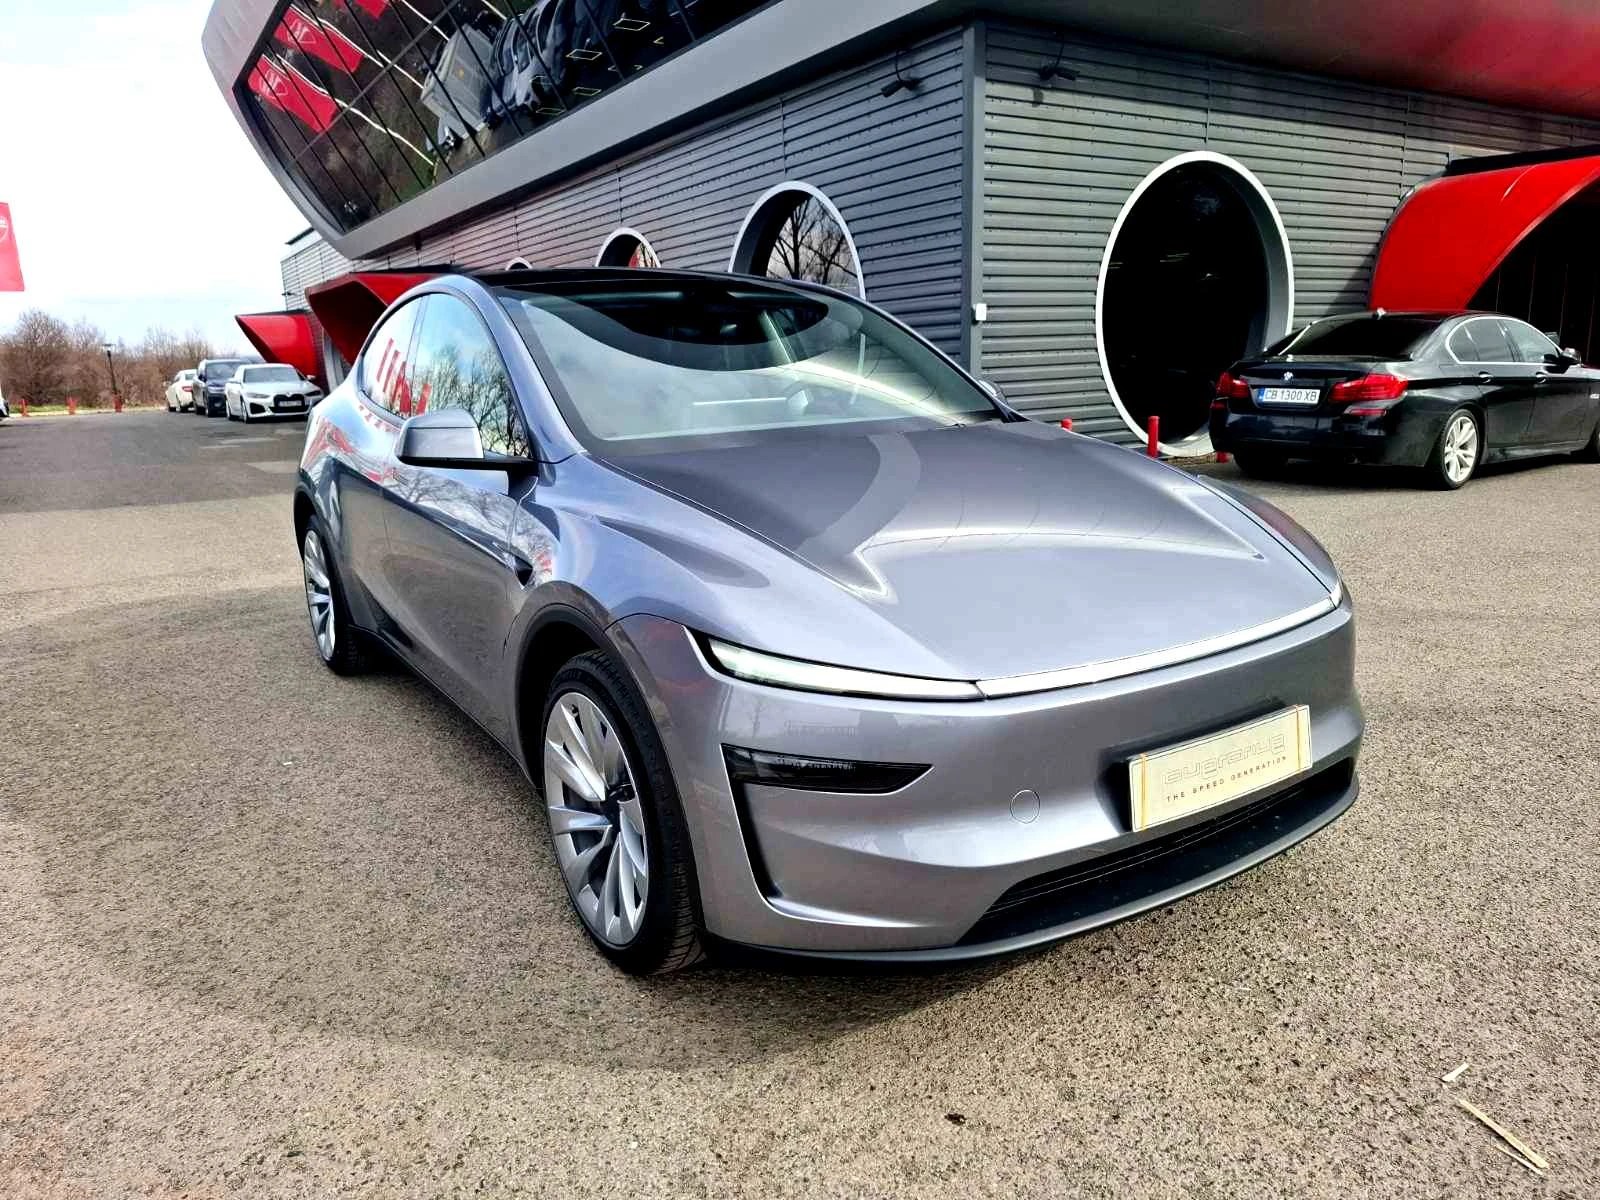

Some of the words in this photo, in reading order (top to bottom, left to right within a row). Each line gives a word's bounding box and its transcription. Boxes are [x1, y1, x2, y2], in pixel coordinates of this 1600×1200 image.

[1280, 390, 1303, 401] 1300
[1167, 791, 1185, 803] THE
[1192, 778, 1225, 794] SPEED
[1230, 756, 1287, 781] GENERATION
